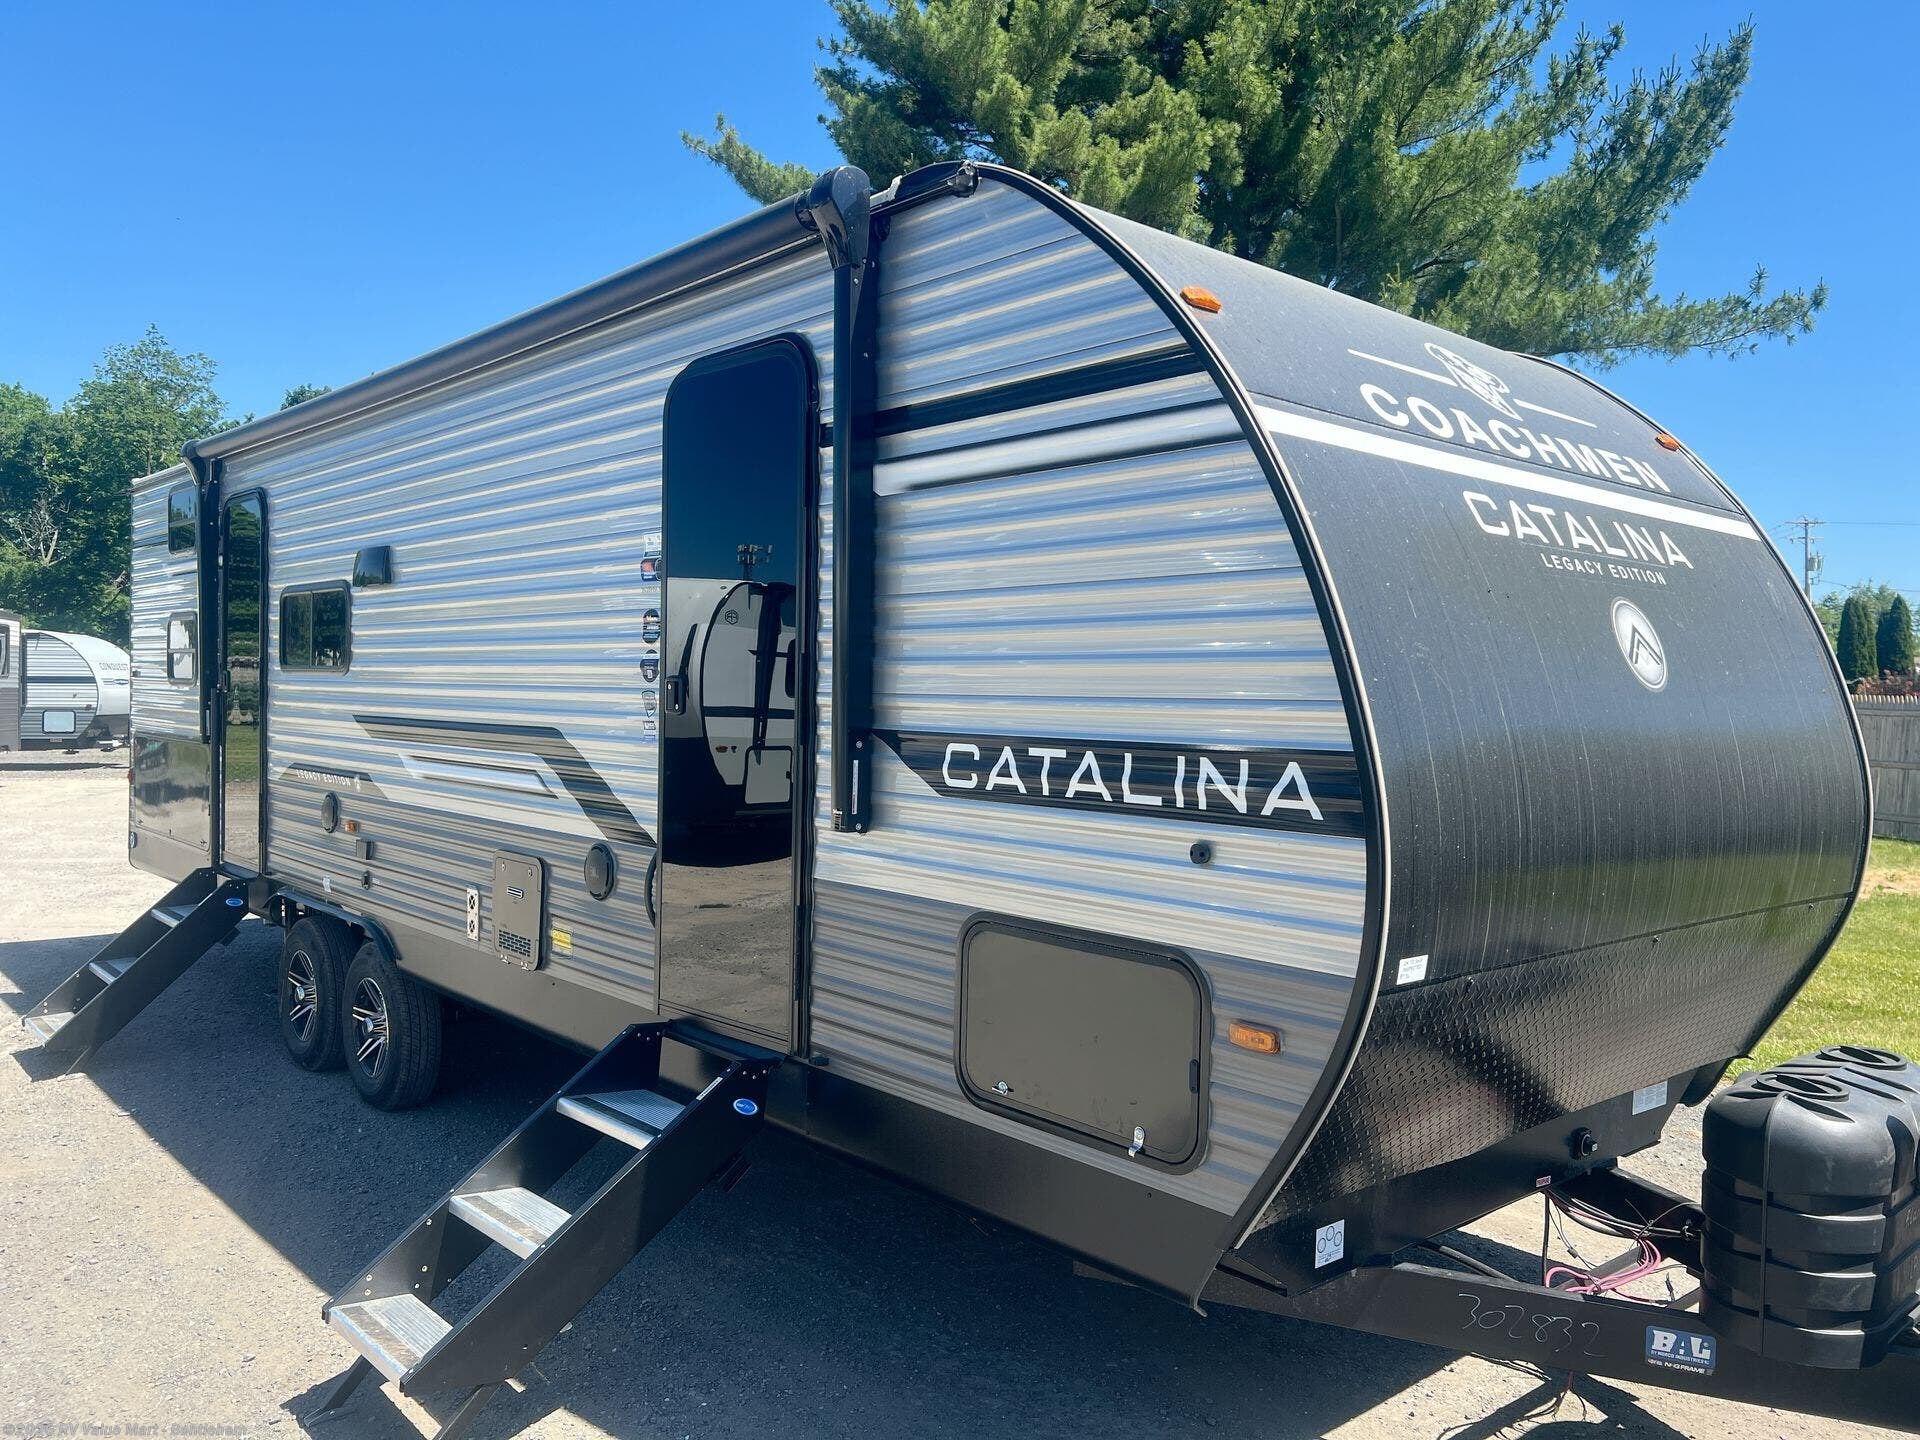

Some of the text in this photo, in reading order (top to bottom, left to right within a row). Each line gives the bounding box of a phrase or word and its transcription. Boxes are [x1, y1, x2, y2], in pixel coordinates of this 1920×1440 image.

[1359, 383, 1671, 492] COACHMEN
[1462, 490, 1694, 569] CATALINA
[1540, 553, 1667, 586] LEGACY EDITION
[296, 769, 351, 786] LEGACY EDITION
[942, 742, 1324, 821] CATALINA
[1458, 1293, 1608, 1358] 302832
